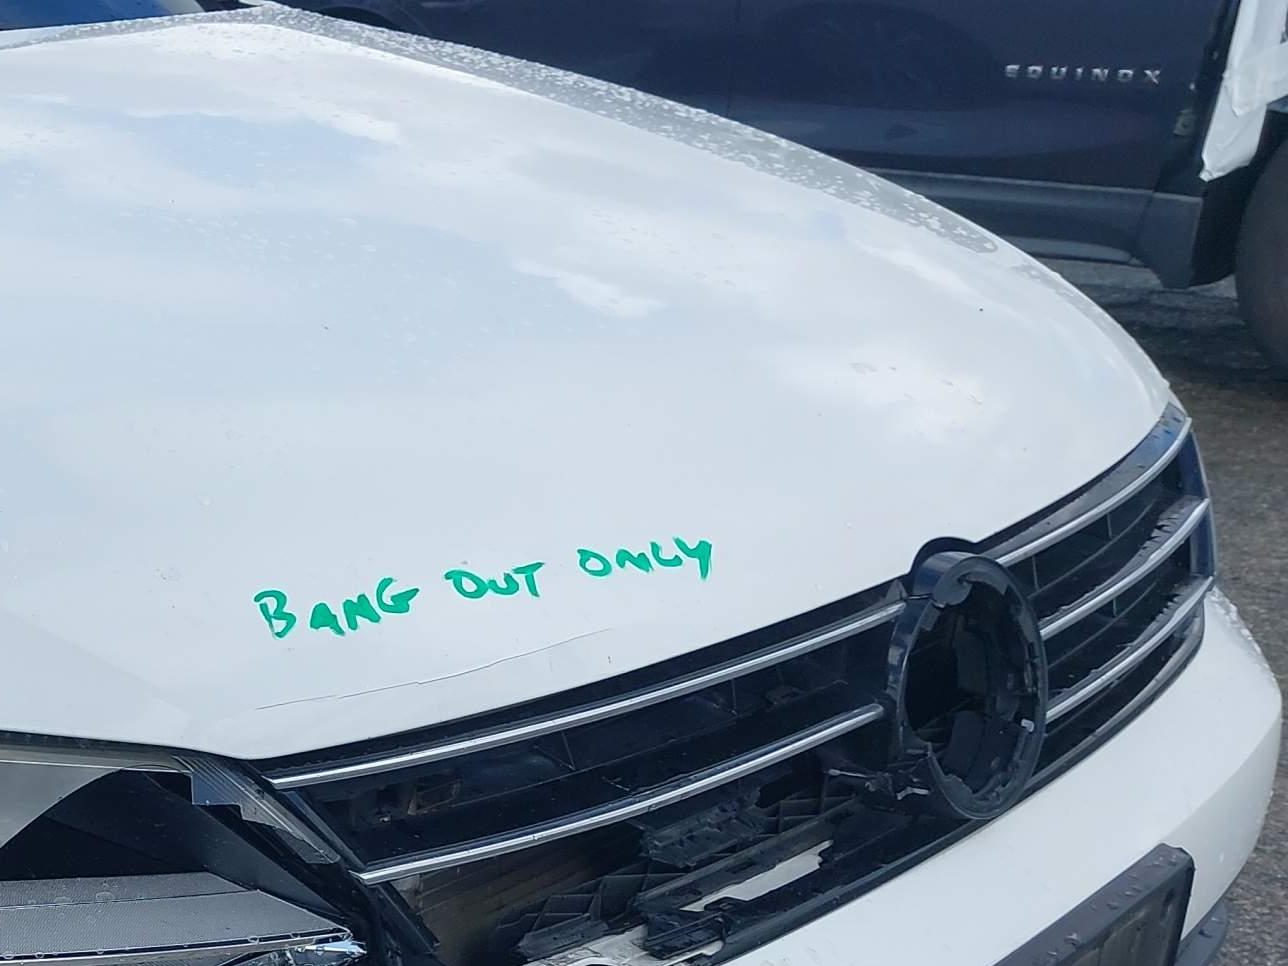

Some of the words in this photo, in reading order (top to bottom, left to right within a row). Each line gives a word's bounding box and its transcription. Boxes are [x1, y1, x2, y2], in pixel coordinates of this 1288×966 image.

[1005, 64, 1161, 84] EQUINOX
[253, 576, 420, 640] BANG
[443, 561, 545, 600] OUT
[575, 536, 713, 581] ONLY
